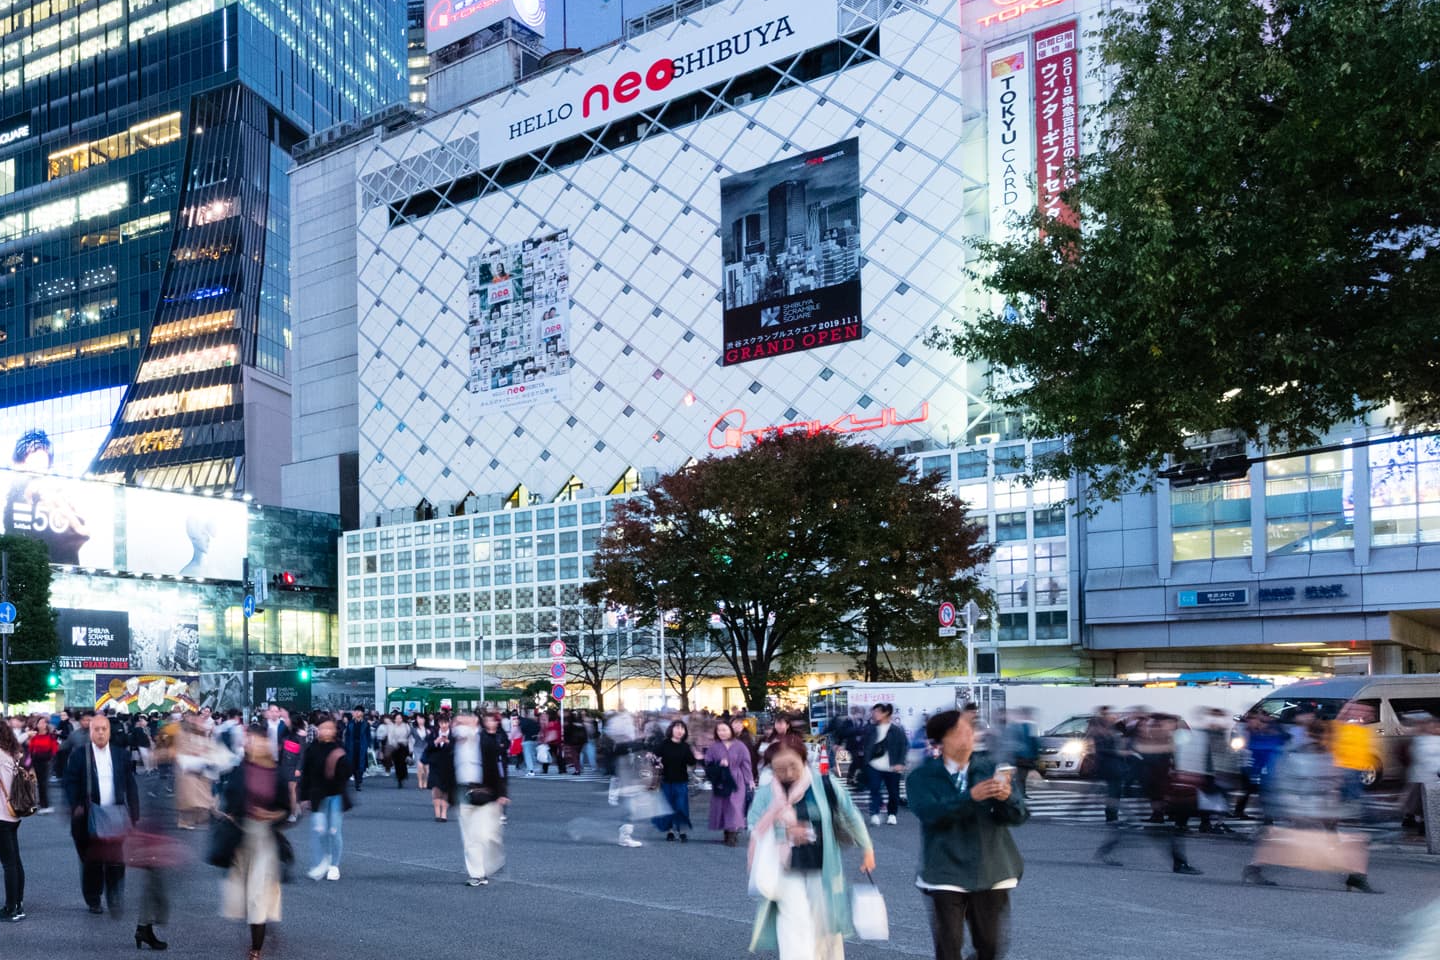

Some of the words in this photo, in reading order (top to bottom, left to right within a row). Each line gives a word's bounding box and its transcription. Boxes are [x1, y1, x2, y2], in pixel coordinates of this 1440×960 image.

[509, 103, 573, 140] HELLO
[582, 58, 676, 118] neo
[671, 15, 796, 79] SHIBUYA
[1000, 76, 1017, 145] TOKYU
[1001, 149, 1018, 206] CARD
[783, 299, 815, 311] SHIBUYA
[783, 302, 821, 317] SCRAMBLE
[783, 311, 812, 323] SQUARE
[726, 324, 817, 351] 渋谷スクランブルスクエア
[726, 337, 795, 363] GRAND
[802, 324, 859, 347] OPEN
[88, 627, 110, 635] SHIBUYA
[82, 660, 108, 669] GRAND
[110, 660, 129, 669] OPEN
